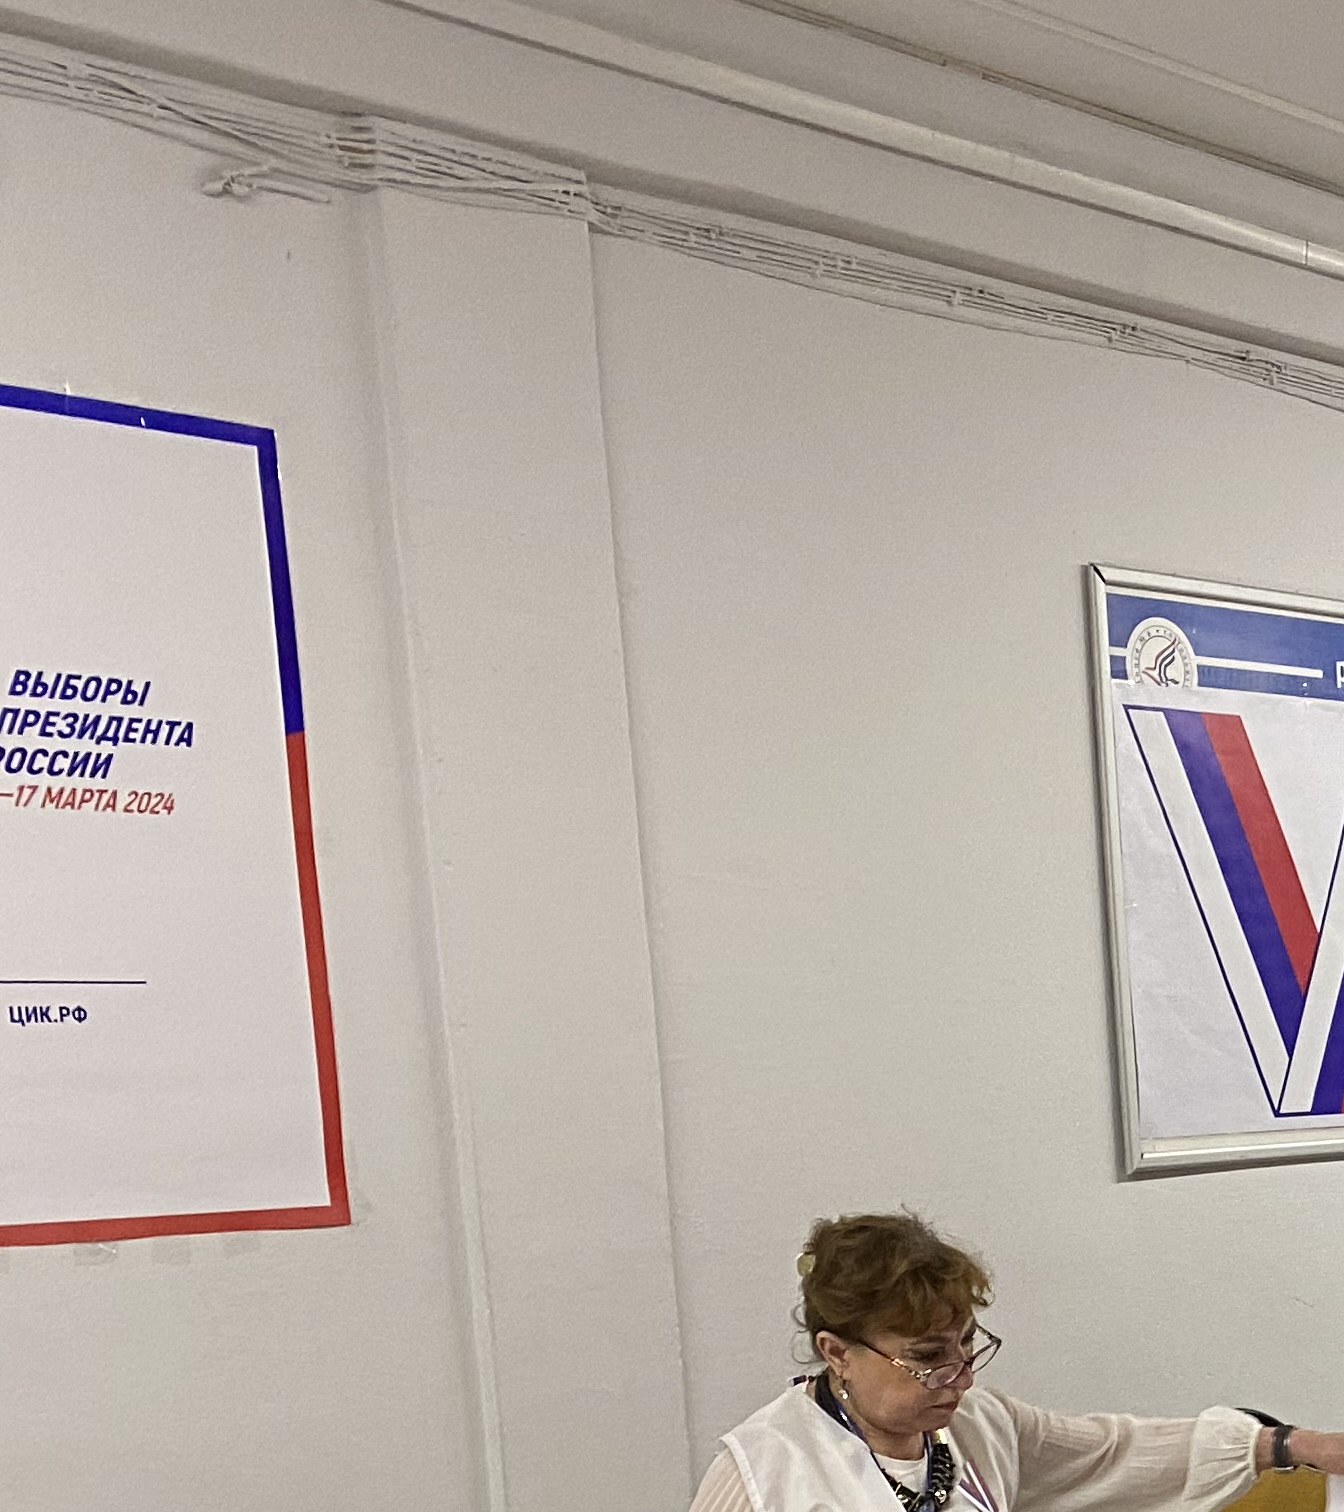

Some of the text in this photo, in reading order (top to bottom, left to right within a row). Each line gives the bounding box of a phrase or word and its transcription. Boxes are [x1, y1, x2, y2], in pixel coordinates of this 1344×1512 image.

[8, 670, 151, 706] ВЫБОРЫ
[0, 707, 194, 747] ПРЕЗИДЕНТА
[41, 786, 118, 812] МАРТА
[123, 790, 175, 815] 2024
[9, 1005, 87, 1027] ЦИК.РФ
